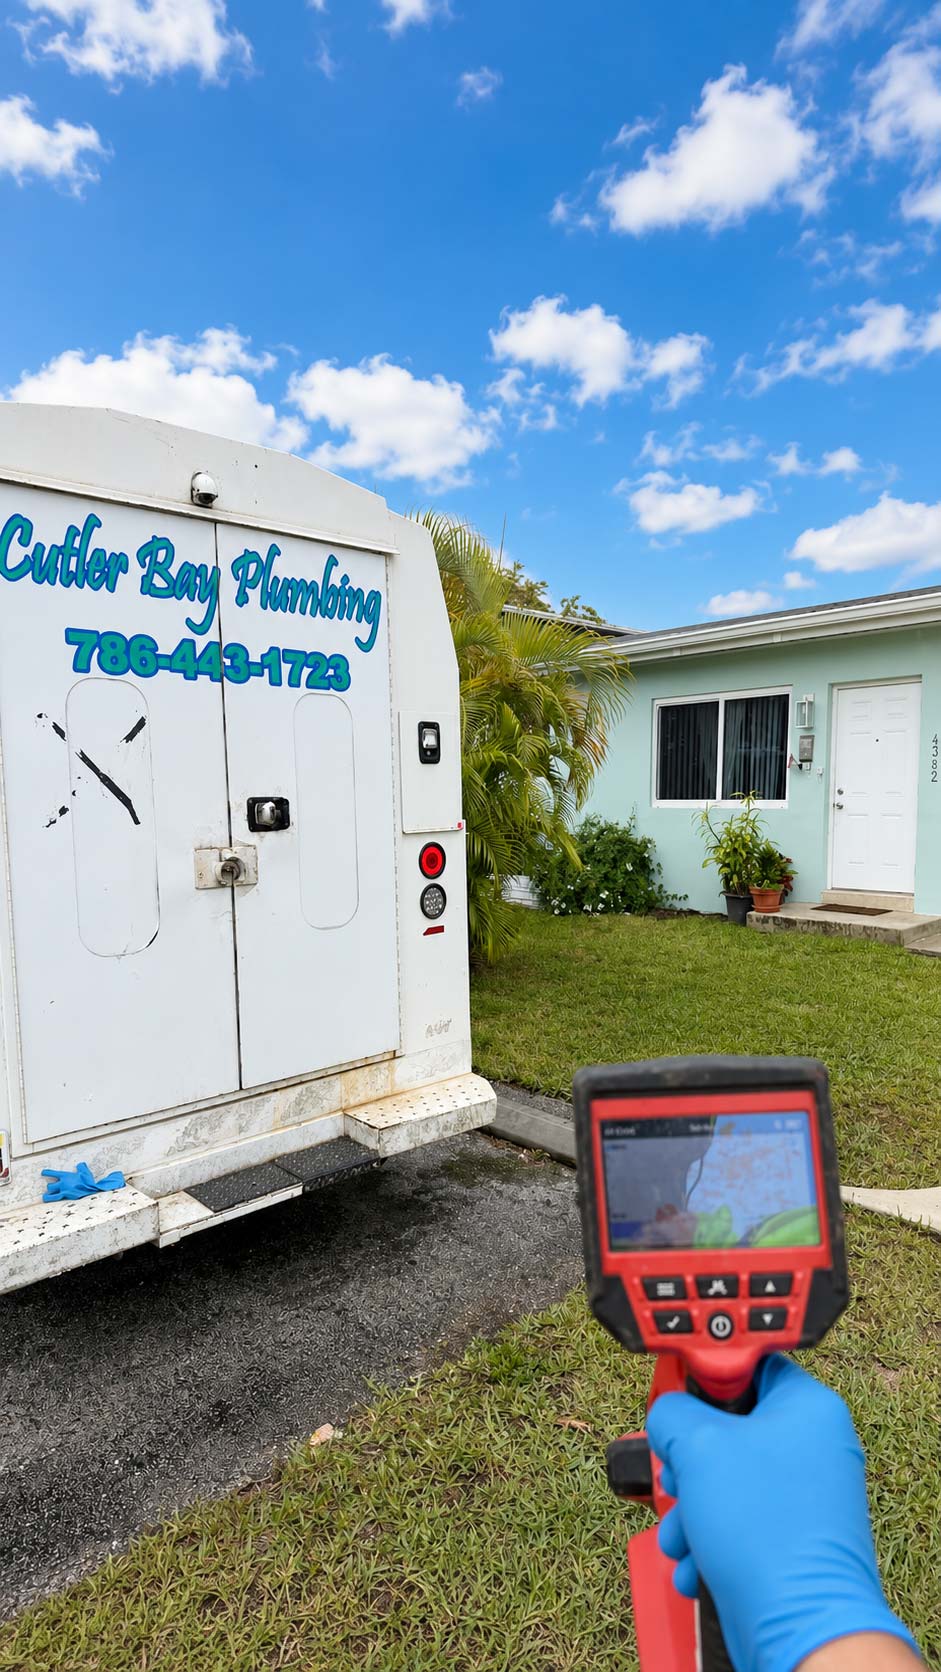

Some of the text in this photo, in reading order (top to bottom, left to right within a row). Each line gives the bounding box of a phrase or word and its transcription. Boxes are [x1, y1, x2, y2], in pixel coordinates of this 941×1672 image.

[0, 513, 382, 653] Cutler Bay Plumbing
[65, 627, 351, 692] 786-443-1723
[931, 733, 939, 783] 4382
